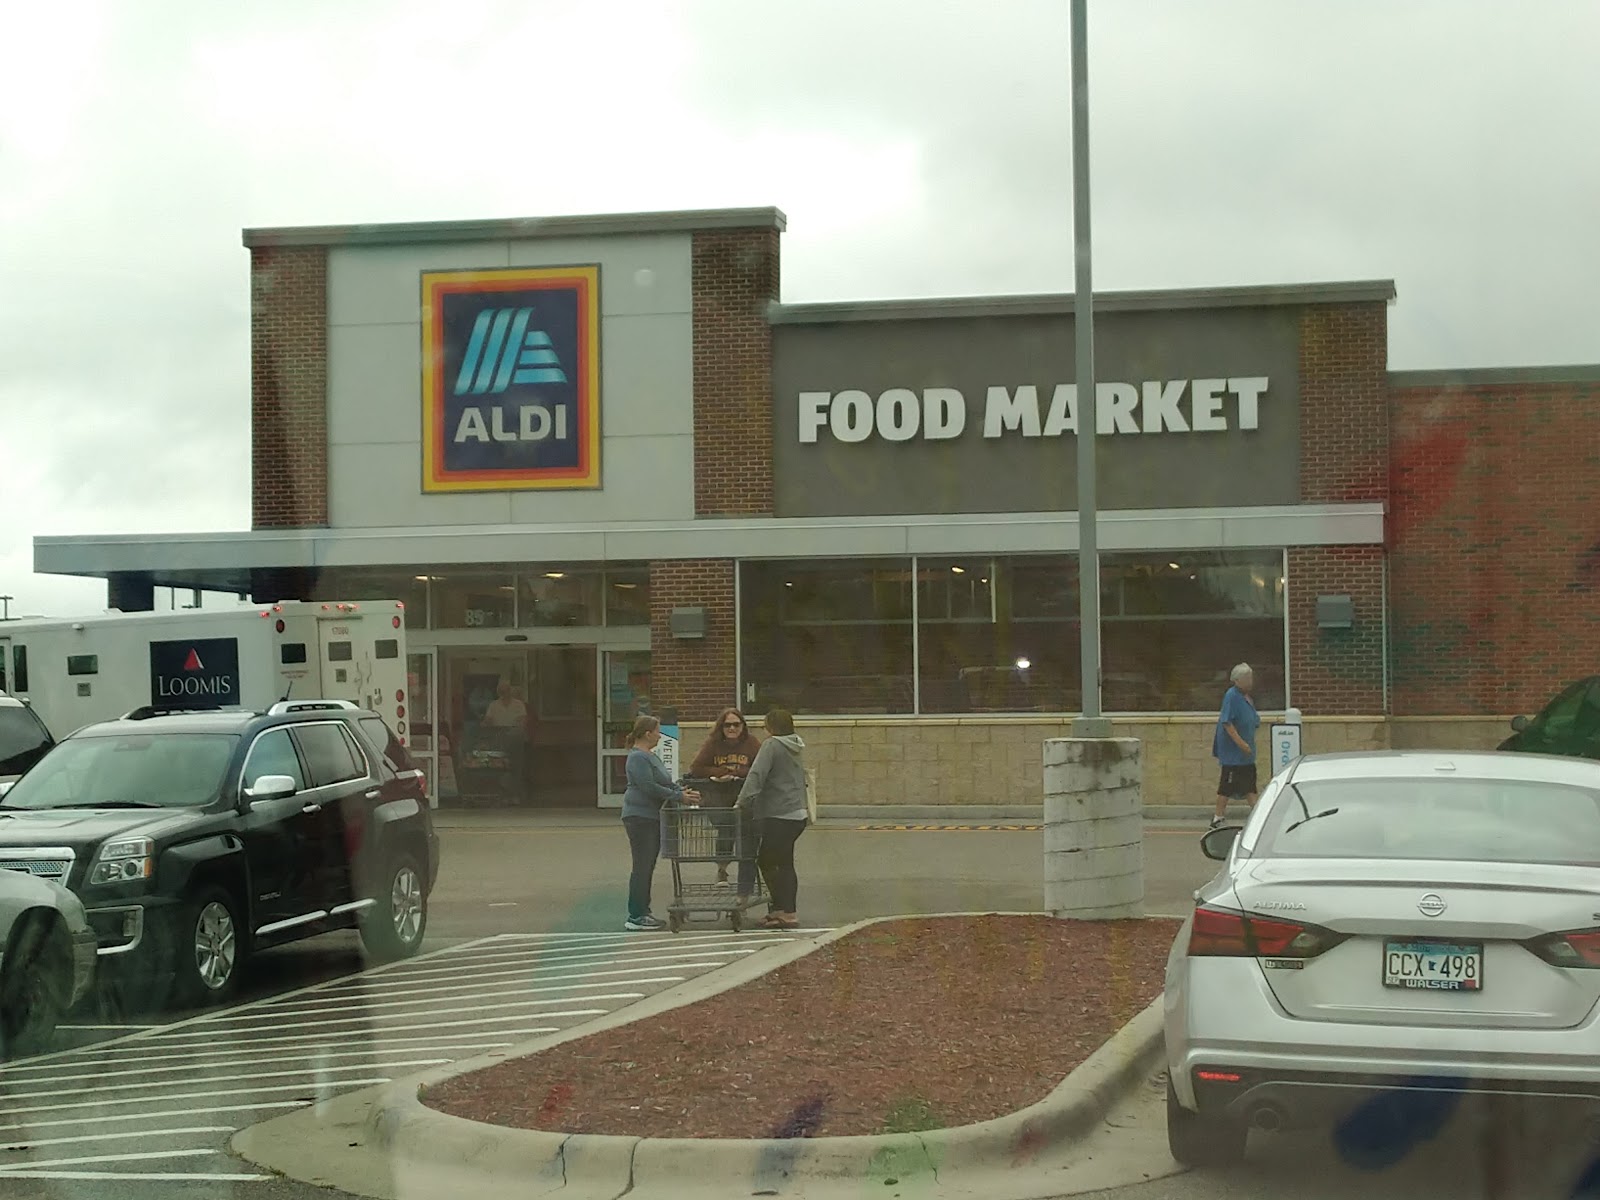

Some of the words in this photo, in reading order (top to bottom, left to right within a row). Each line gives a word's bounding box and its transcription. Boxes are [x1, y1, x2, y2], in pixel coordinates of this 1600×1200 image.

[799, 388, 966, 443] FOOD
[983, 377, 1269, 438] MARKET
[453, 404, 567, 442] ALDI
[159, 675, 231, 696] LOOMIS
[1253, 901, 1306, 911] ALTIMA
[1389, 953, 1424, 976] CCX
[1440, 955, 1475, 978] 498
[1406, 979, 1459, 990] WALSER
